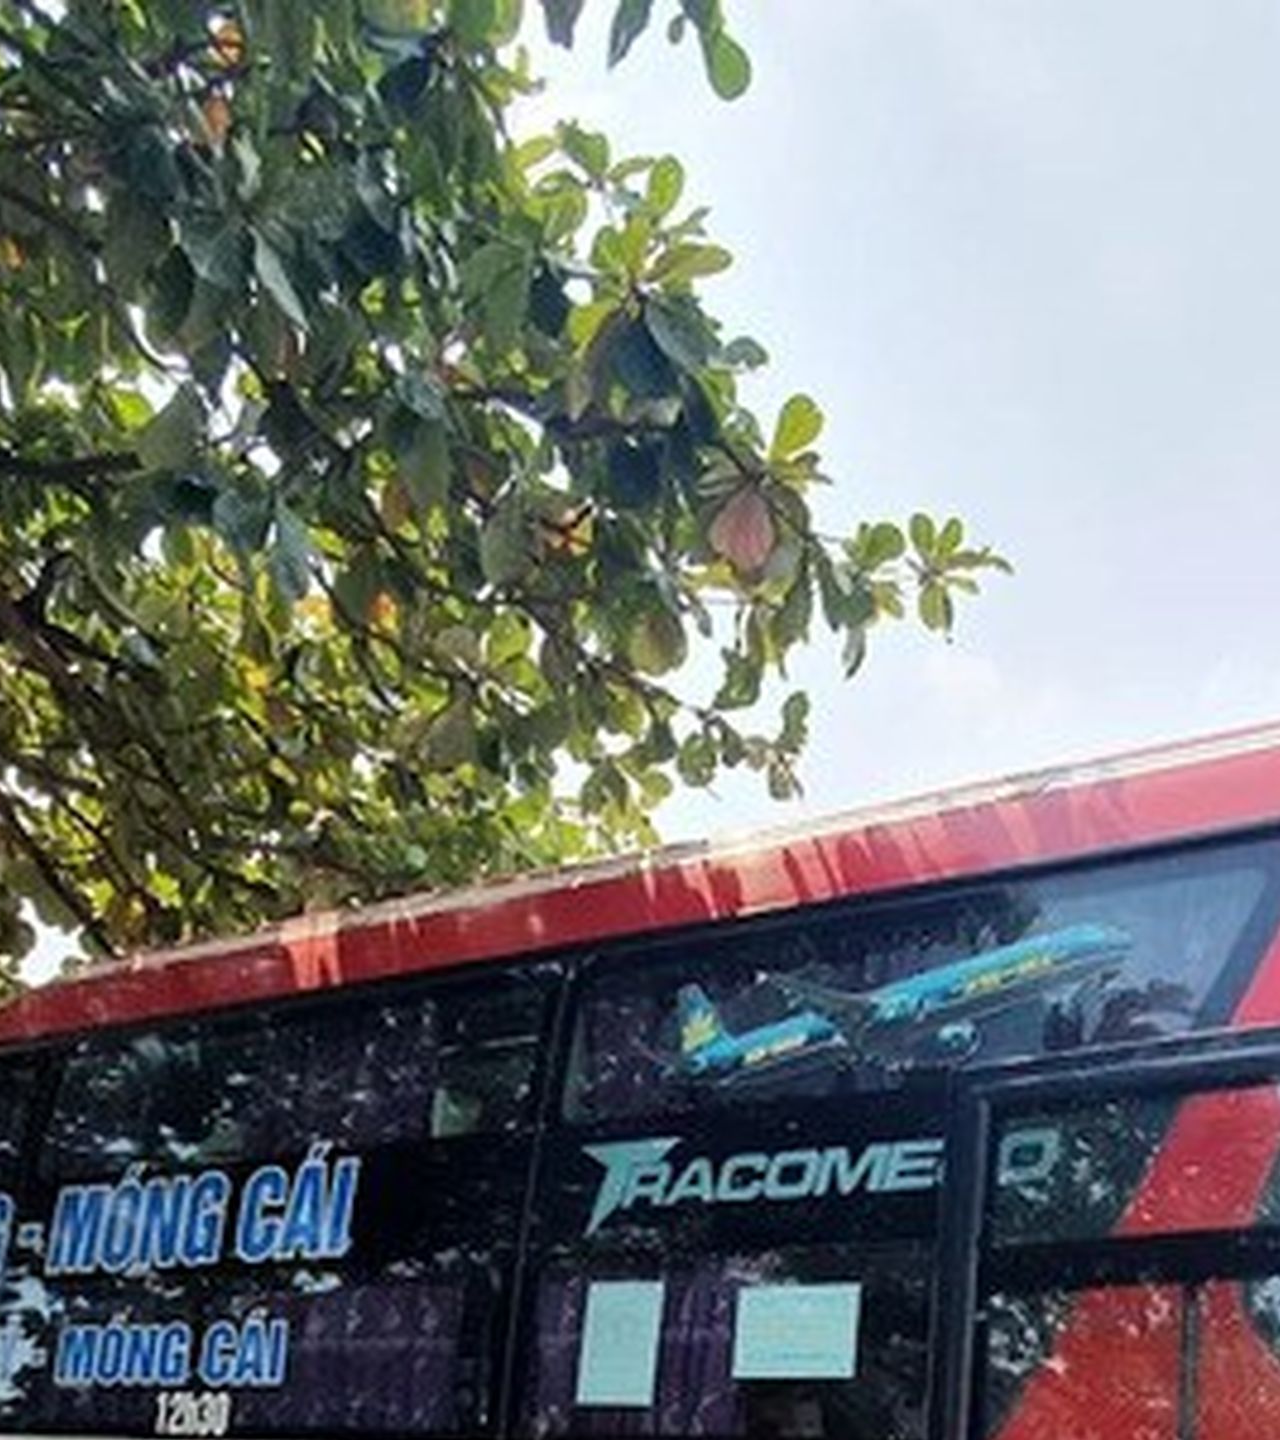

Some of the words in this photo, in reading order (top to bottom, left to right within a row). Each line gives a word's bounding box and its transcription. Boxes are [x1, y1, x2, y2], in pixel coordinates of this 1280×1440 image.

[45, 1161, 231, 1276] MÓNG
[235, 1140, 361, 1263] CÁI
[581, 1127, 1061, 1238] TRACOMEO
[53, 1305, 192, 1387] MÓNG
[198, 1306, 289, 1387] CÁI
